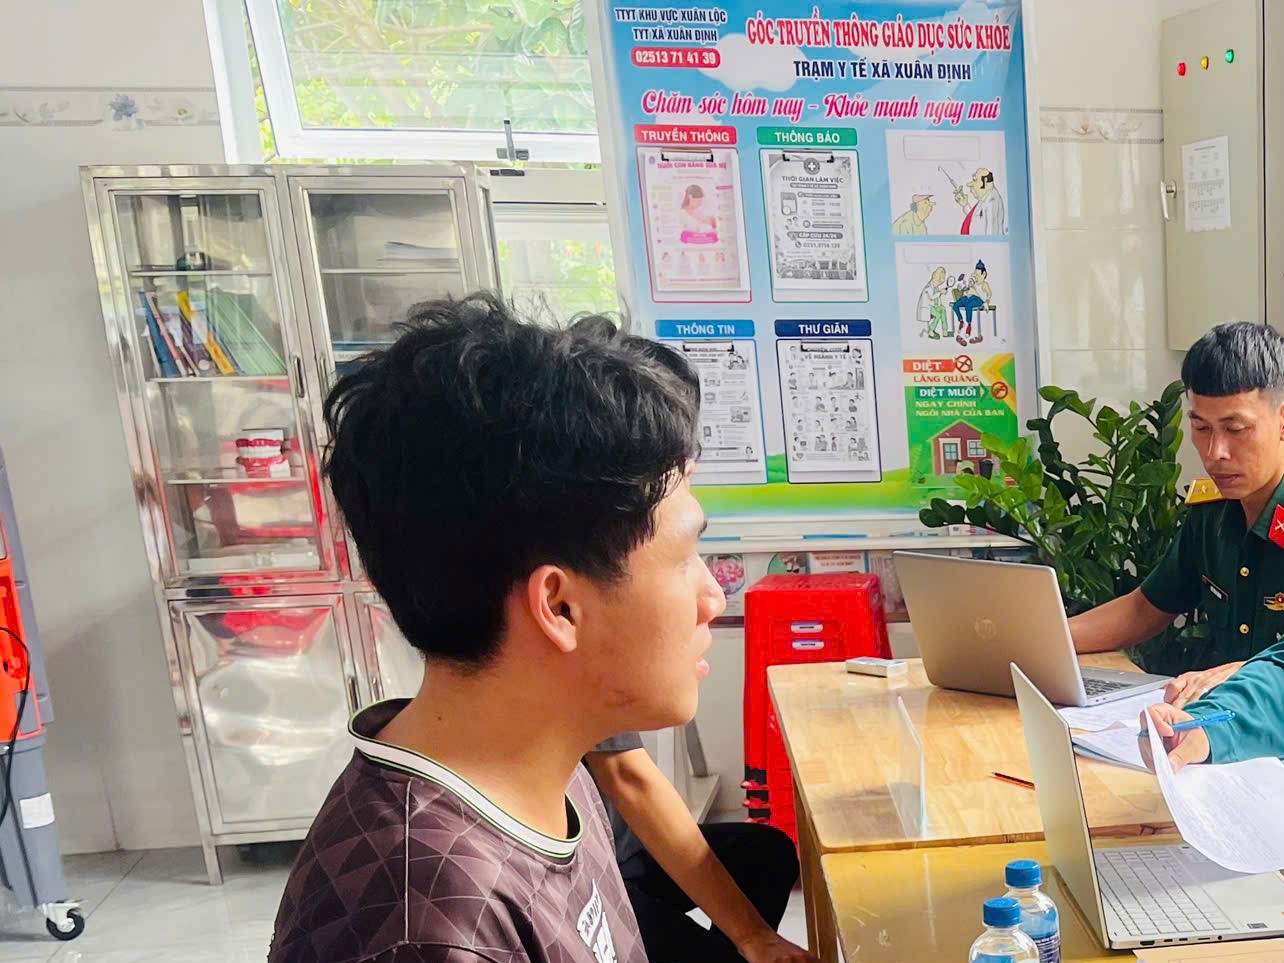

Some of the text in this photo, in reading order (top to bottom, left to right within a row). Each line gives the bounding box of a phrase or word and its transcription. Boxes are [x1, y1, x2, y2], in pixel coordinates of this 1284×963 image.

[615, 8, 727, 25] TTYT KHU VỰC XUÂN LỘC
[633, 26, 718, 44] TYT XÃ XUÂN ĐỊNH
[747, 7, 1011, 55] GÓC TRUYỀN THÔNG GIÁO DỤC SỨC KHỎE
[635, 50, 716, 64] 02513 71 41 39
[793, 57, 972, 83] TRẠM Y TẾ XÃ XUÂN ĐỊNH
[642, 90, 692, 115] Chăm
[698, 92, 727, 115] sóc
[730, 92, 767, 116] hôm
[772, 97, 804, 122] nay
[824, 93, 869, 118] Khỏe
[873, 95, 919, 122] mạnh
[923, 97, 964, 125] ngày
[967, 97, 1001, 120] mai
[641, 127, 730, 143] TRUYỀN THÔNG
[774, 130, 841, 144] THÔNG BÁO
[676, 323, 735, 335] THÔNG TIN
[798, 322, 849, 334] THƯ GIÃN
